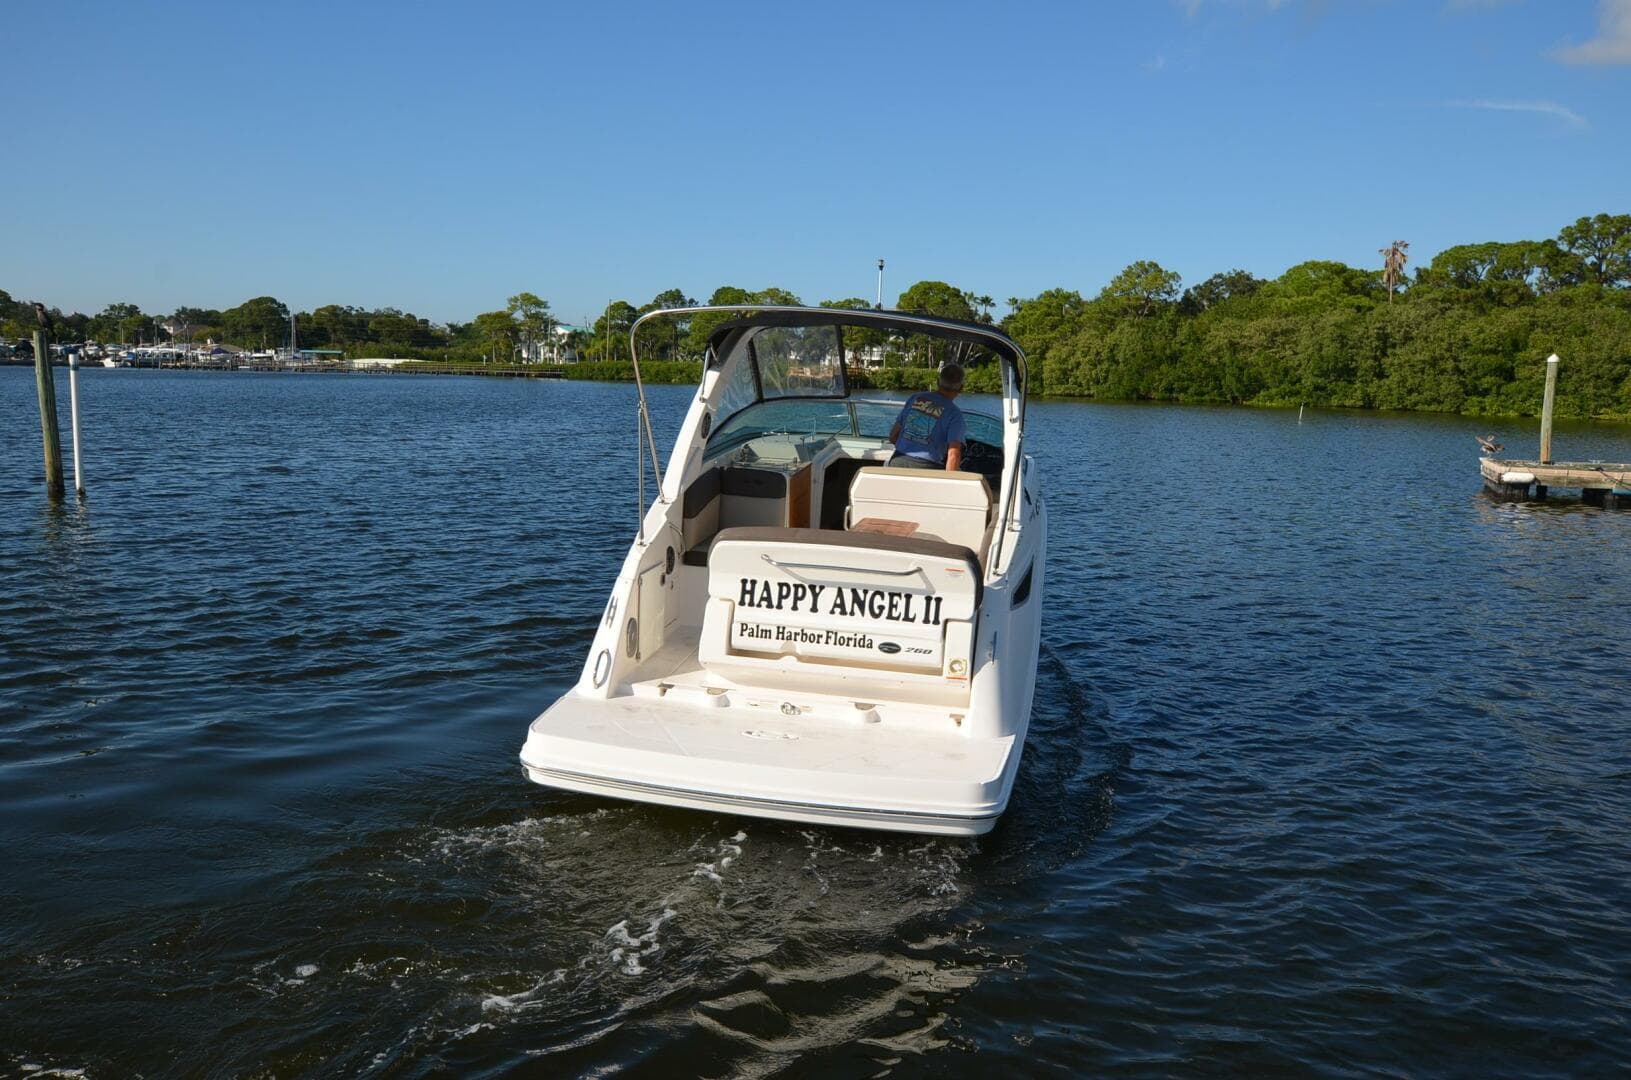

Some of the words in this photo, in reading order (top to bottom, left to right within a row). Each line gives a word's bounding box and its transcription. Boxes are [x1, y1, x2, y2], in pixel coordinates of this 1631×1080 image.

[738, 578, 825, 613] HAPPY
[829, 586, 917, 625] ANGEL
[922, 595, 944, 626] II
[739, 622, 772, 640] Palm
[775, 626, 823, 645] Harbor
[824, 630, 874, 650] Florida
[905, 647, 933, 656] 260
